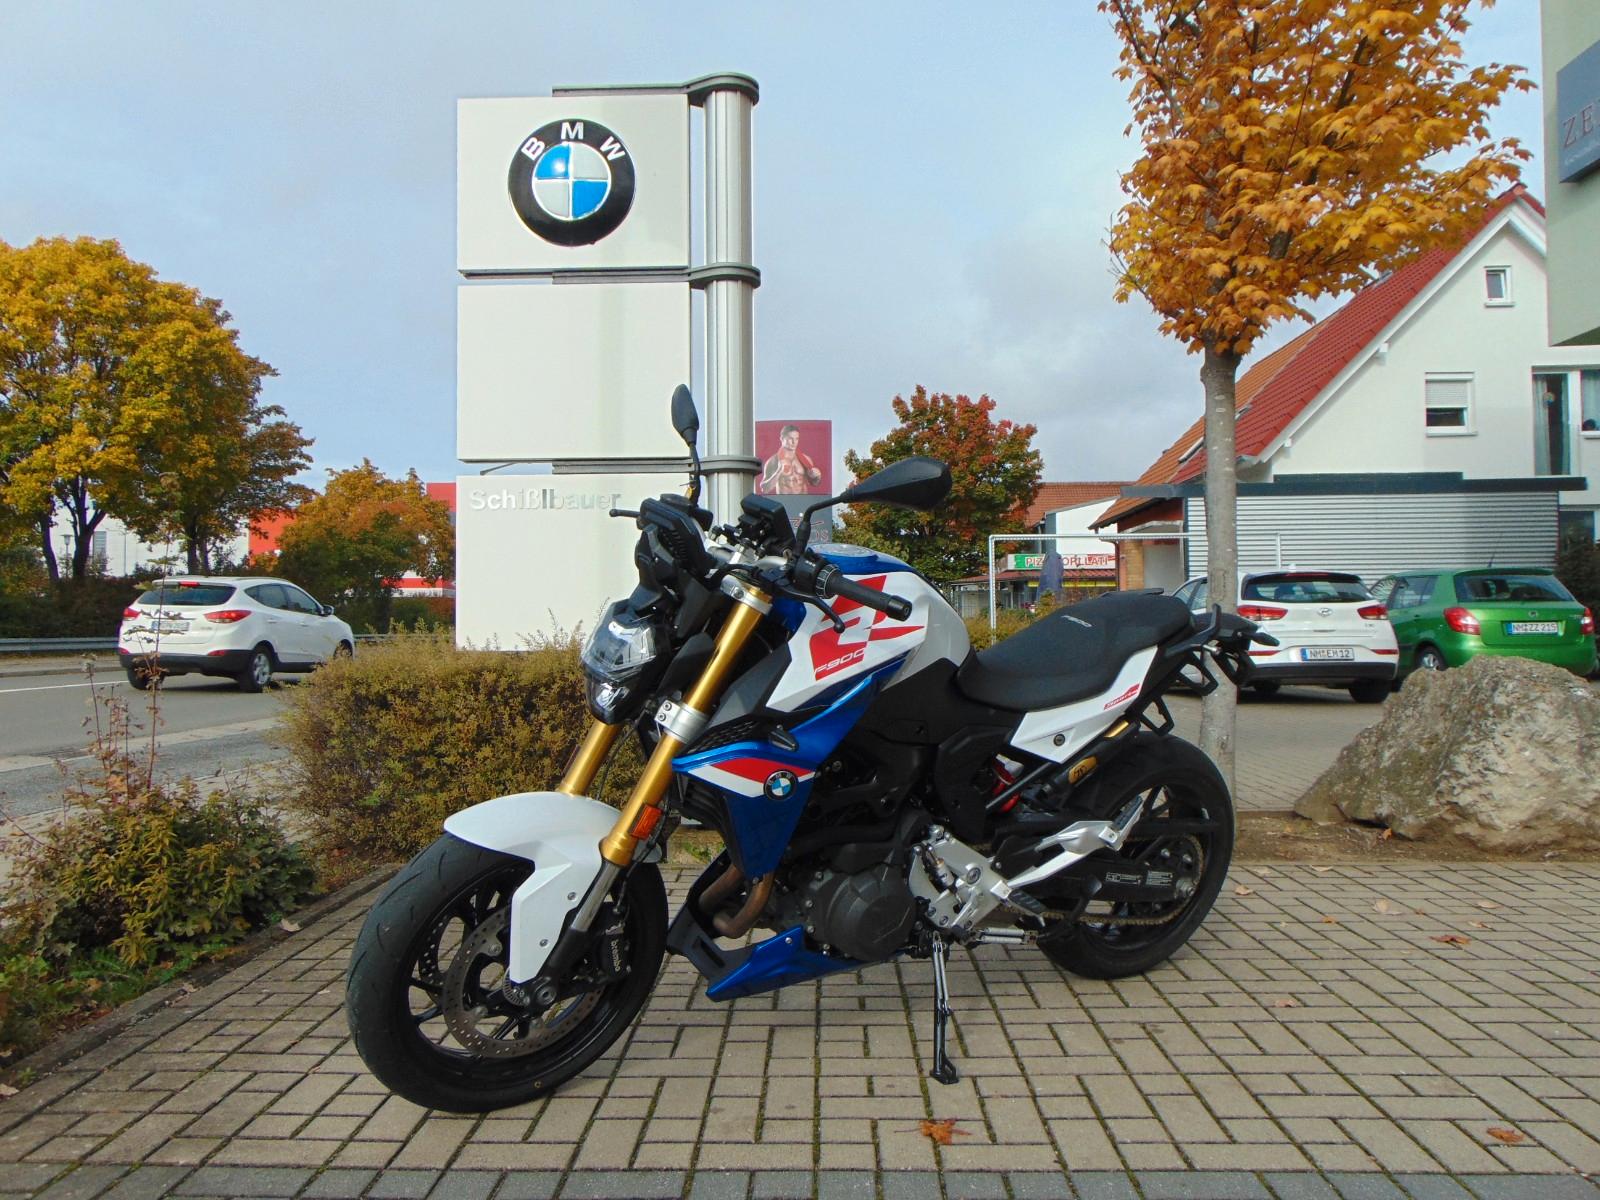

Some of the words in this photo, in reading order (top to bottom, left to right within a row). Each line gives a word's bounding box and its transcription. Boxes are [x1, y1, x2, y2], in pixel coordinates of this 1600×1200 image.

[520, 121, 626, 162] BMW
[1562, 100, 1600, 149] ZE
[470, 487, 622, 511] Schißlbauer
